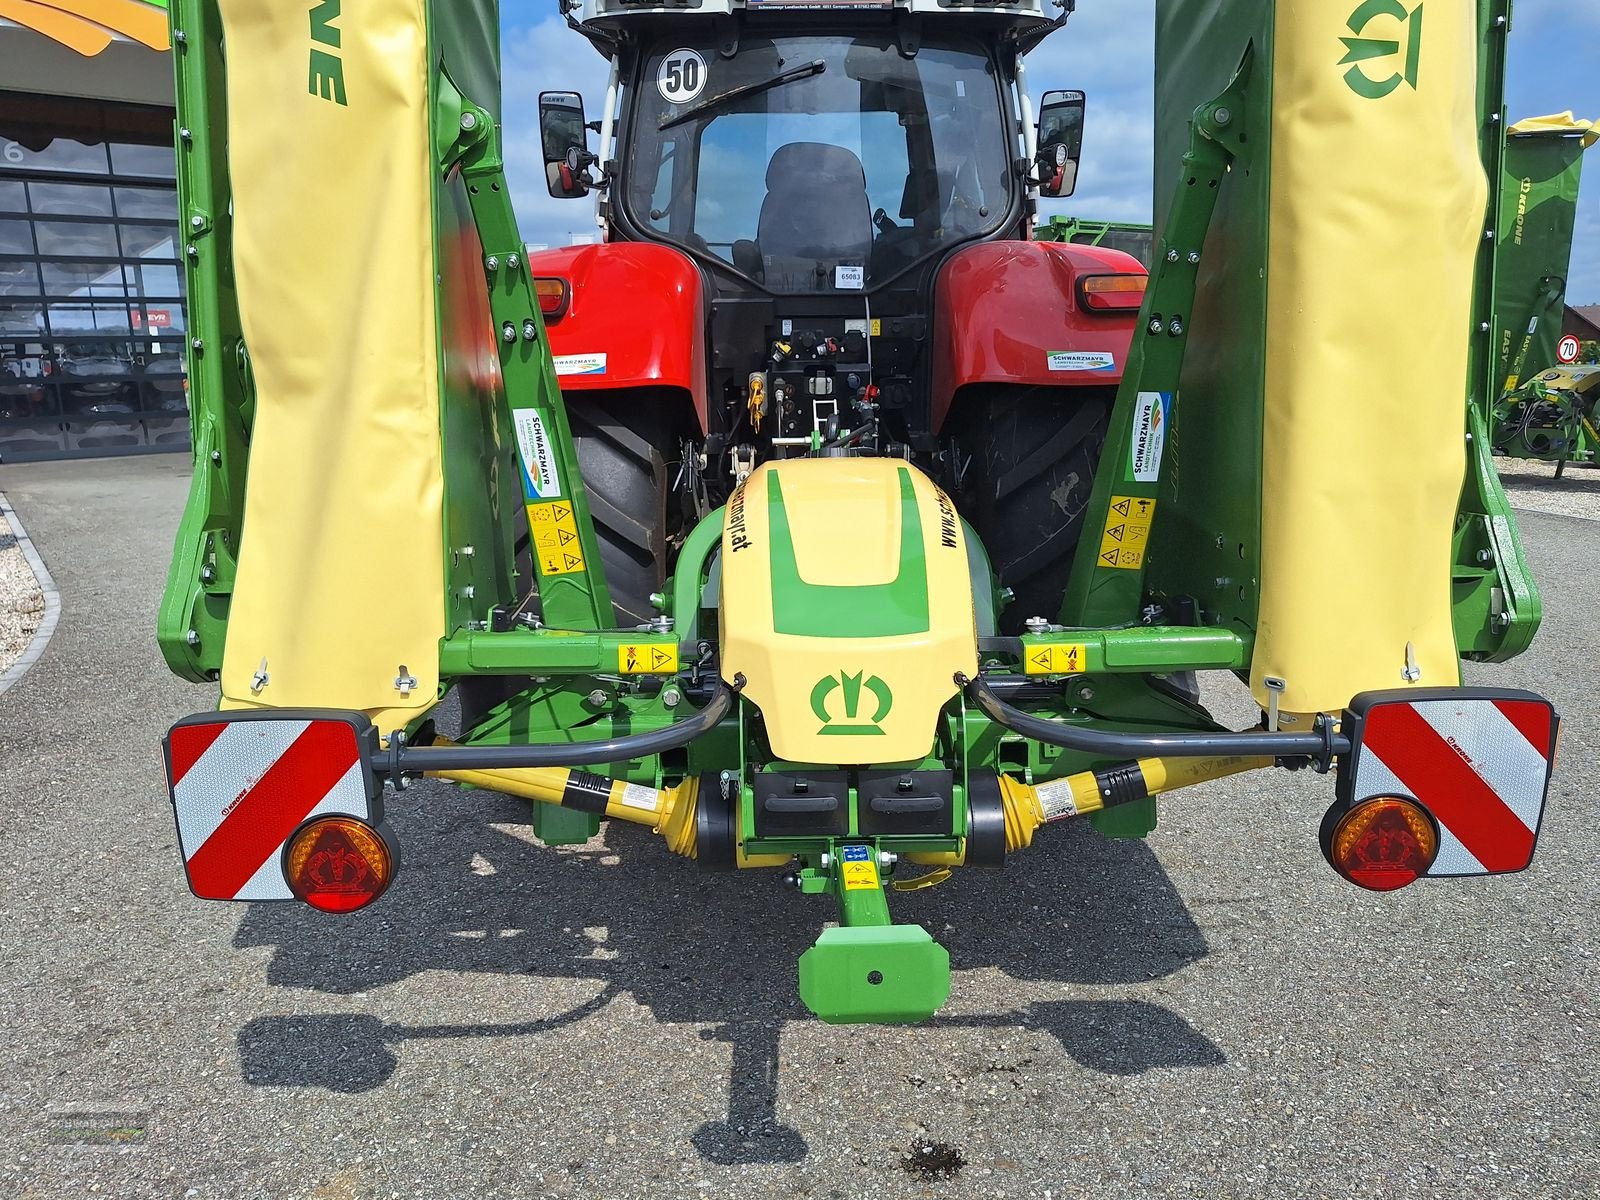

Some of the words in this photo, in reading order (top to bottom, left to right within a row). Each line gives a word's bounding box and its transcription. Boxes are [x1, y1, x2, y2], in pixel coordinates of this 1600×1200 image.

[666, 58, 699, 93] 50
[4, 142, 24, 162] 6
[1514, 193, 1527, 246] KRONE
[1562, 342, 1575, 357] 70
[525, 418, 536, 459] LANDTECHNIK
[532, 417, 550, 485] SCHWARZMAYR
[1134, 404, 1152, 474] SCHWARZMAYR
[1144, 432, 1154, 472] LANDTECHNIK
[1452, 743, 1473, 764] KRONE
[228, 788, 247, 810] KRONE
